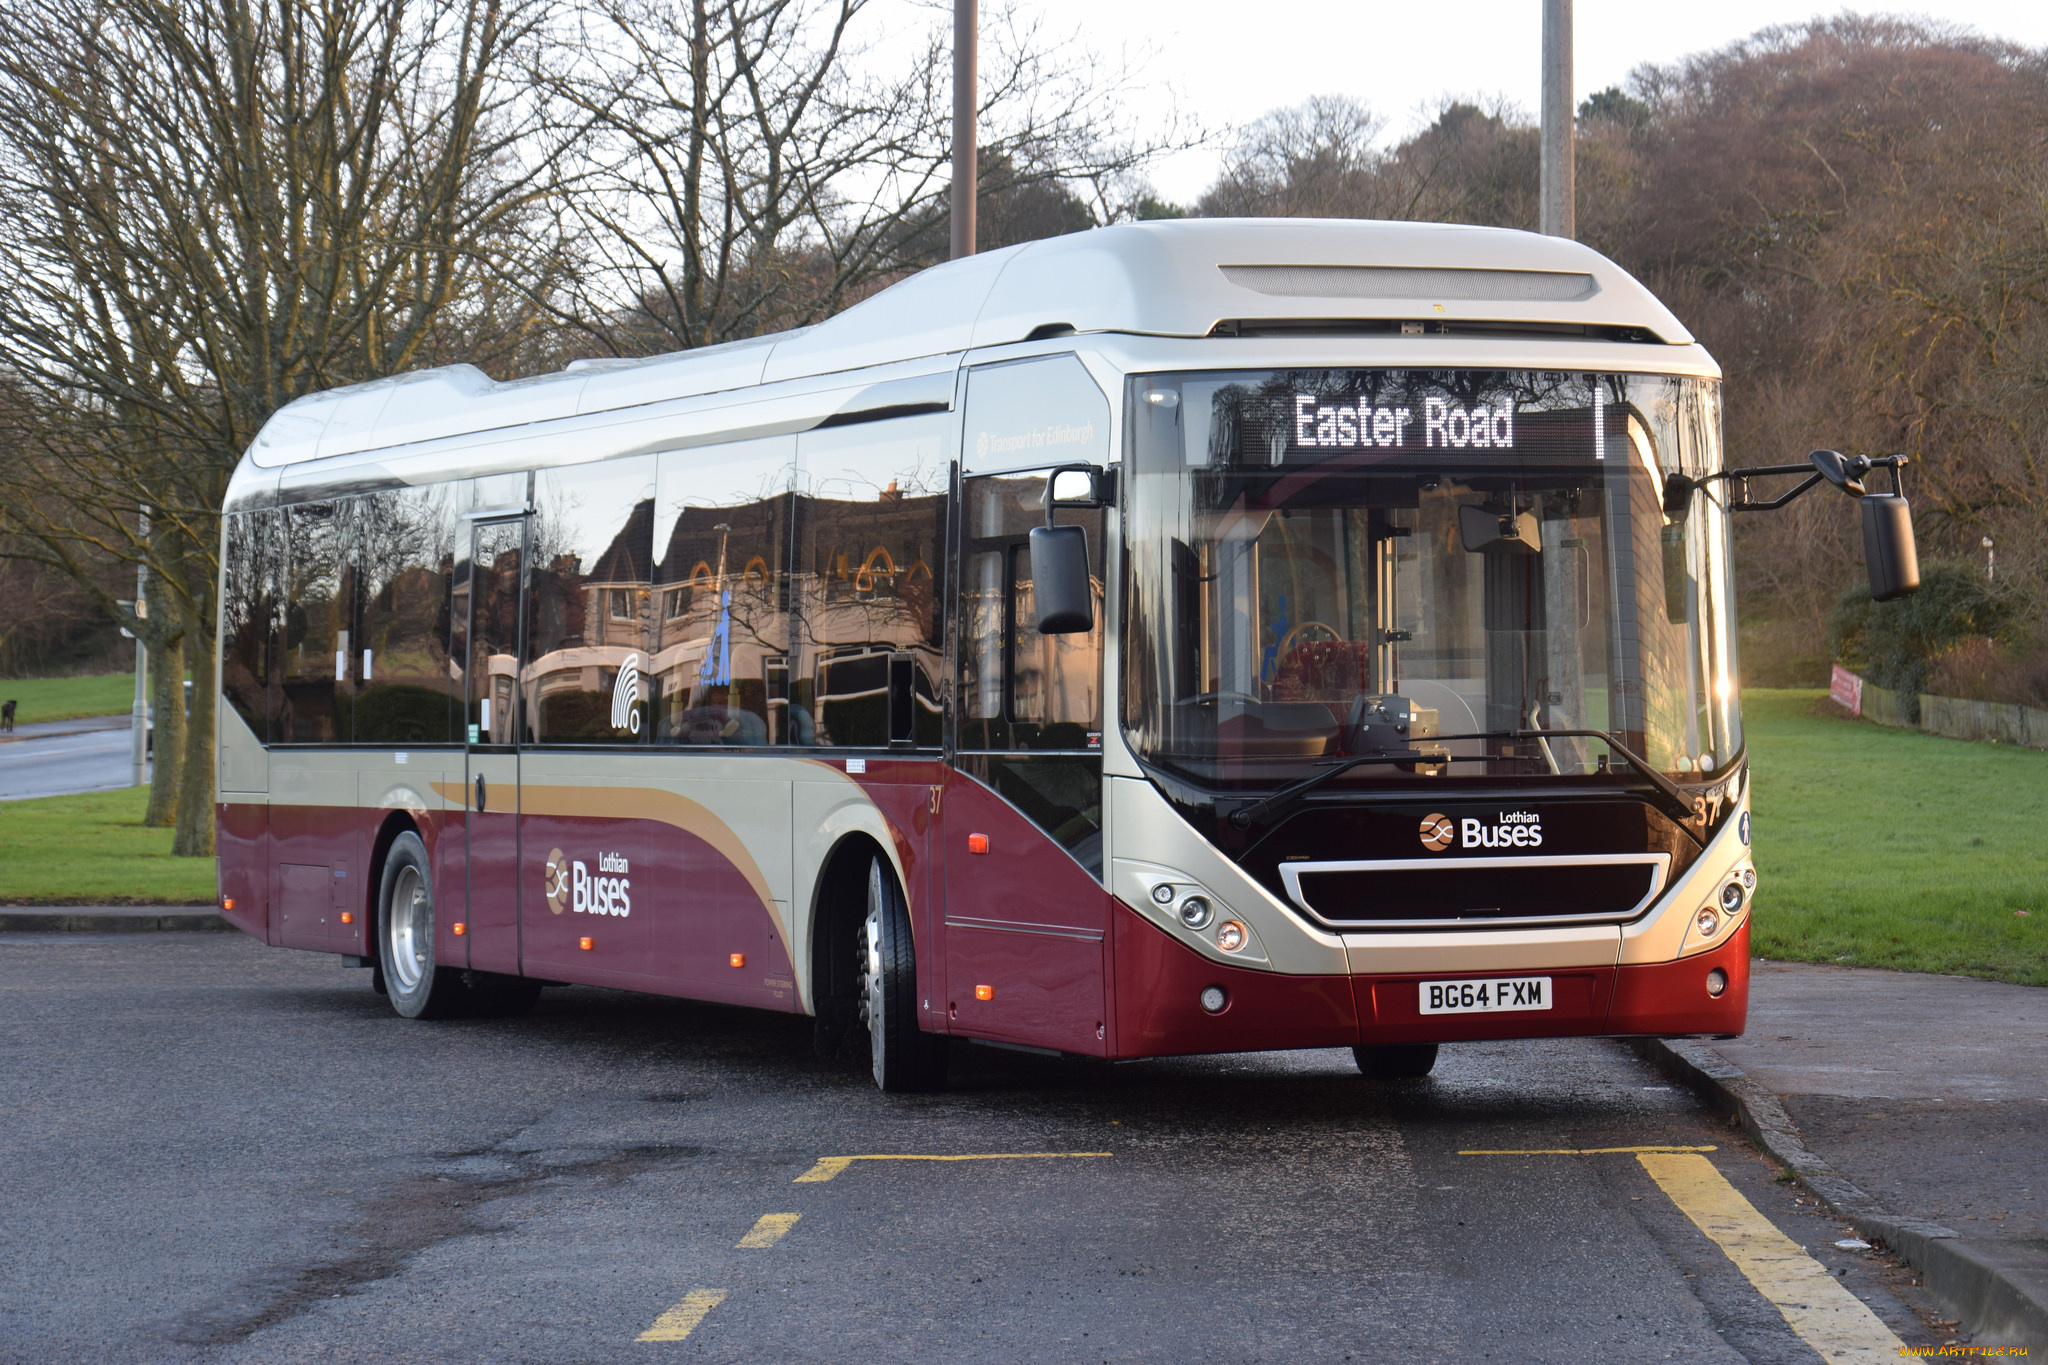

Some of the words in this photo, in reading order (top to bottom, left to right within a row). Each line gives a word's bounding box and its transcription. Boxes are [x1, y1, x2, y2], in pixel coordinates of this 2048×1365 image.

[1296, 395, 1409, 447] Easter
[1425, 396, 1513, 448] Road
[1594, 386, 1605, 460] 1
[990, 431, 1031, 454] Transport
[1031, 427, 1045, 447] for
[1046, 420, 1094, 446] Edinburgh
[929, 786, 942, 814] 37
[1694, 796, 1719, 827] 37
[1499, 811, 1540, 824] Lothian
[1461, 818, 1543, 848] Buses
[599, 851, 629, 874] Lothian
[572, 860, 631, 918] Buses
[1429, 983, 1490, 1009] BG64
[1497, 981, 1542, 1006] FXM
